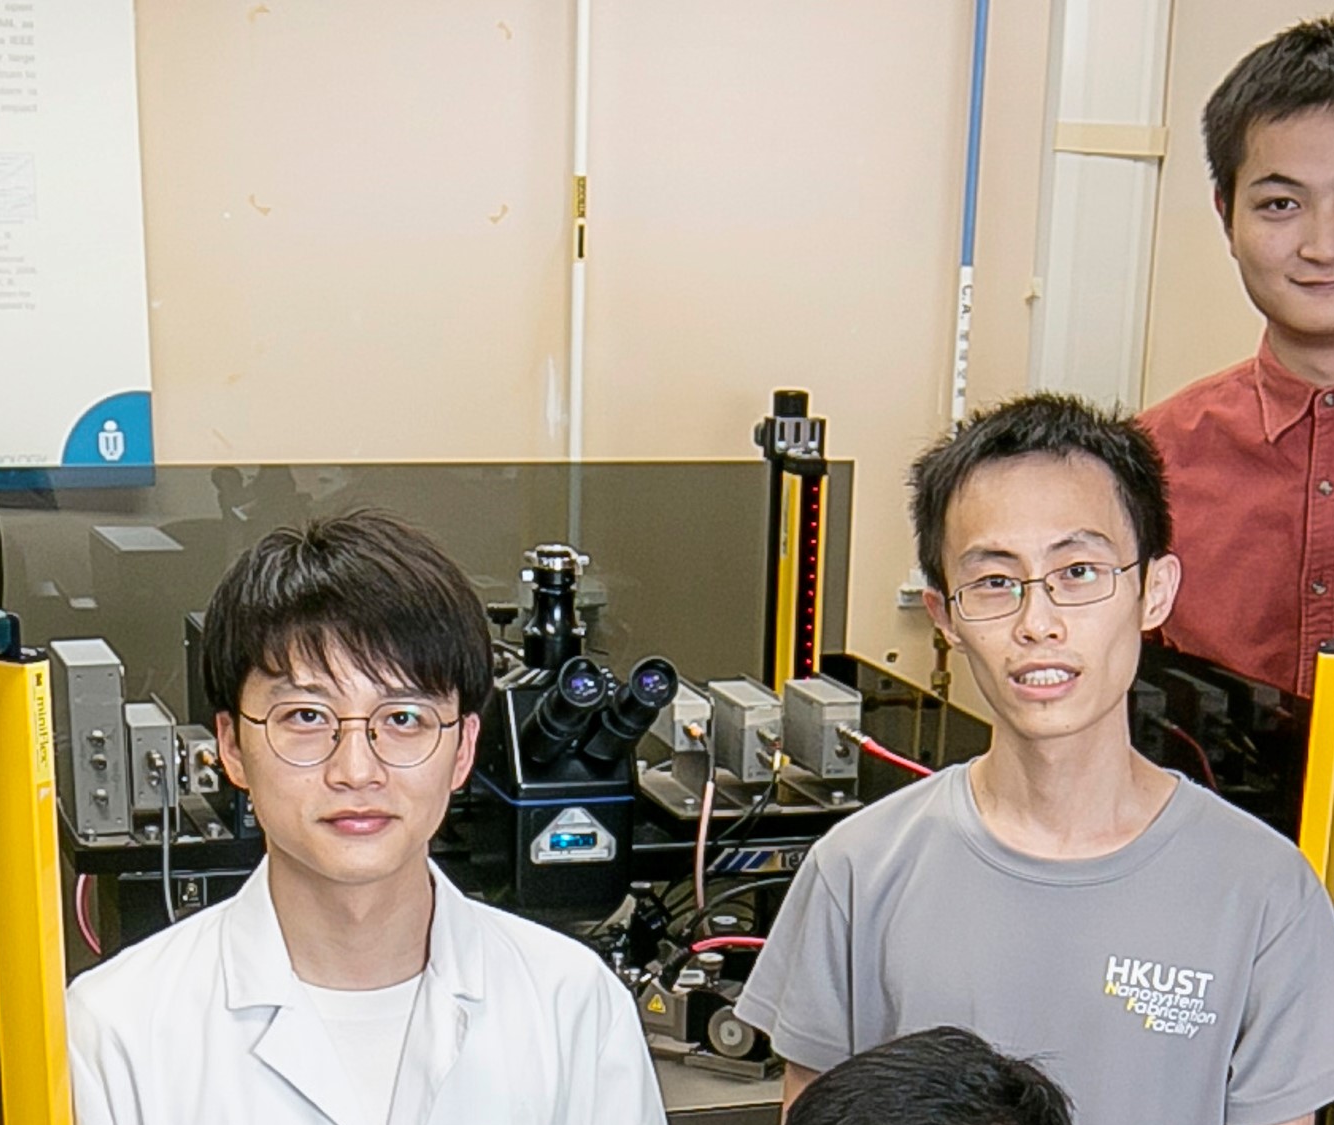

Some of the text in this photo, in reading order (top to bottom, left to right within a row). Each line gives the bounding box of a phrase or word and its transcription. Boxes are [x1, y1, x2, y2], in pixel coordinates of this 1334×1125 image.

[1105, 956, 1214, 998] HKUST
[1104, 981, 1204, 1011] Nanosystem
[1126, 998, 1217, 1025] Fabrication
[1144, 1015, 1200, 1039] Facility
